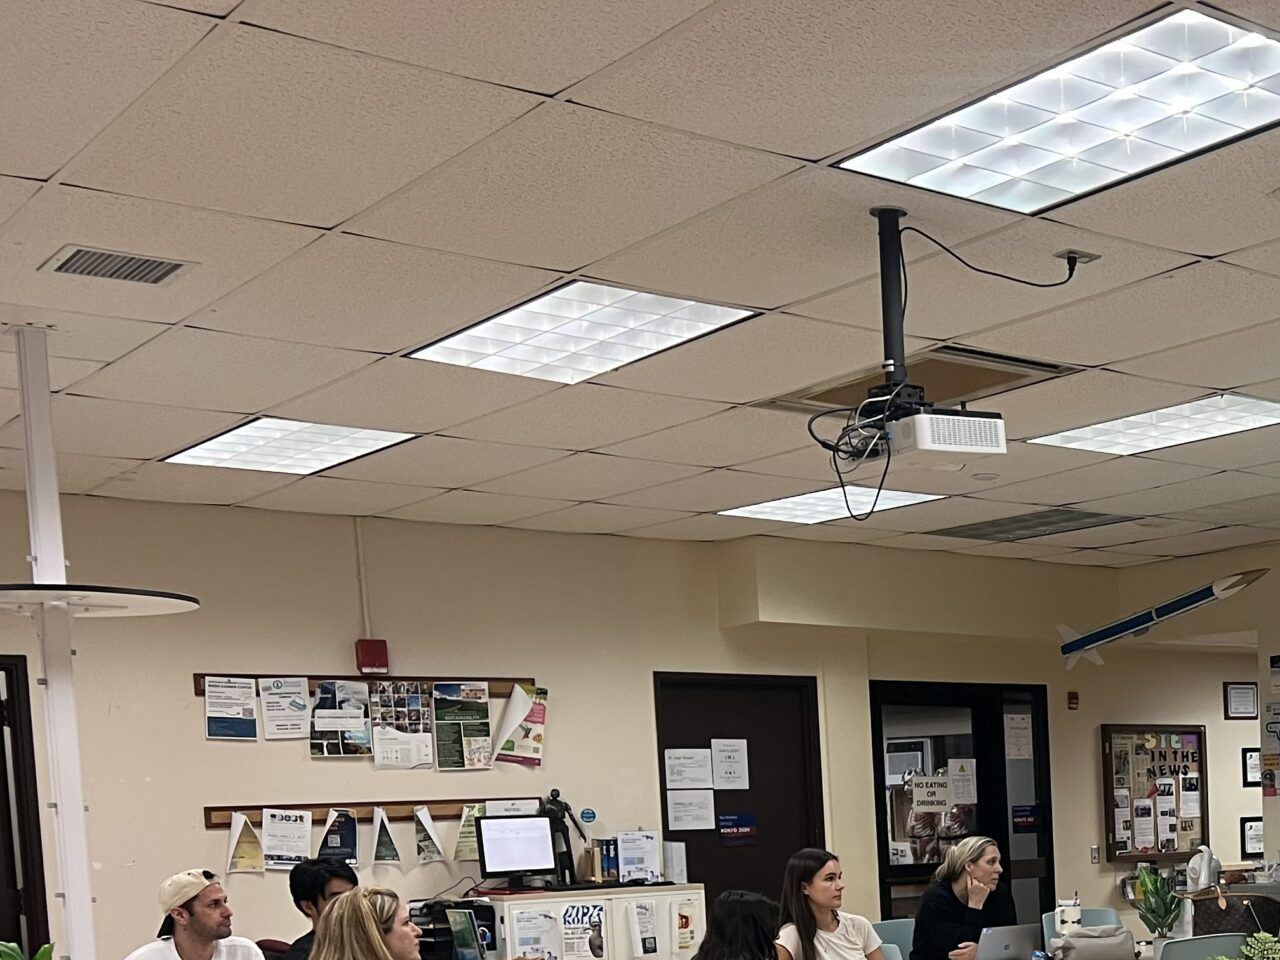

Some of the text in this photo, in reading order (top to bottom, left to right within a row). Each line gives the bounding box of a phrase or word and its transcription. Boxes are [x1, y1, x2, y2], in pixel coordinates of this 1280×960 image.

[1151, 750, 1199, 763] IN THE
[1146, 764, 1190, 778] NEWS
